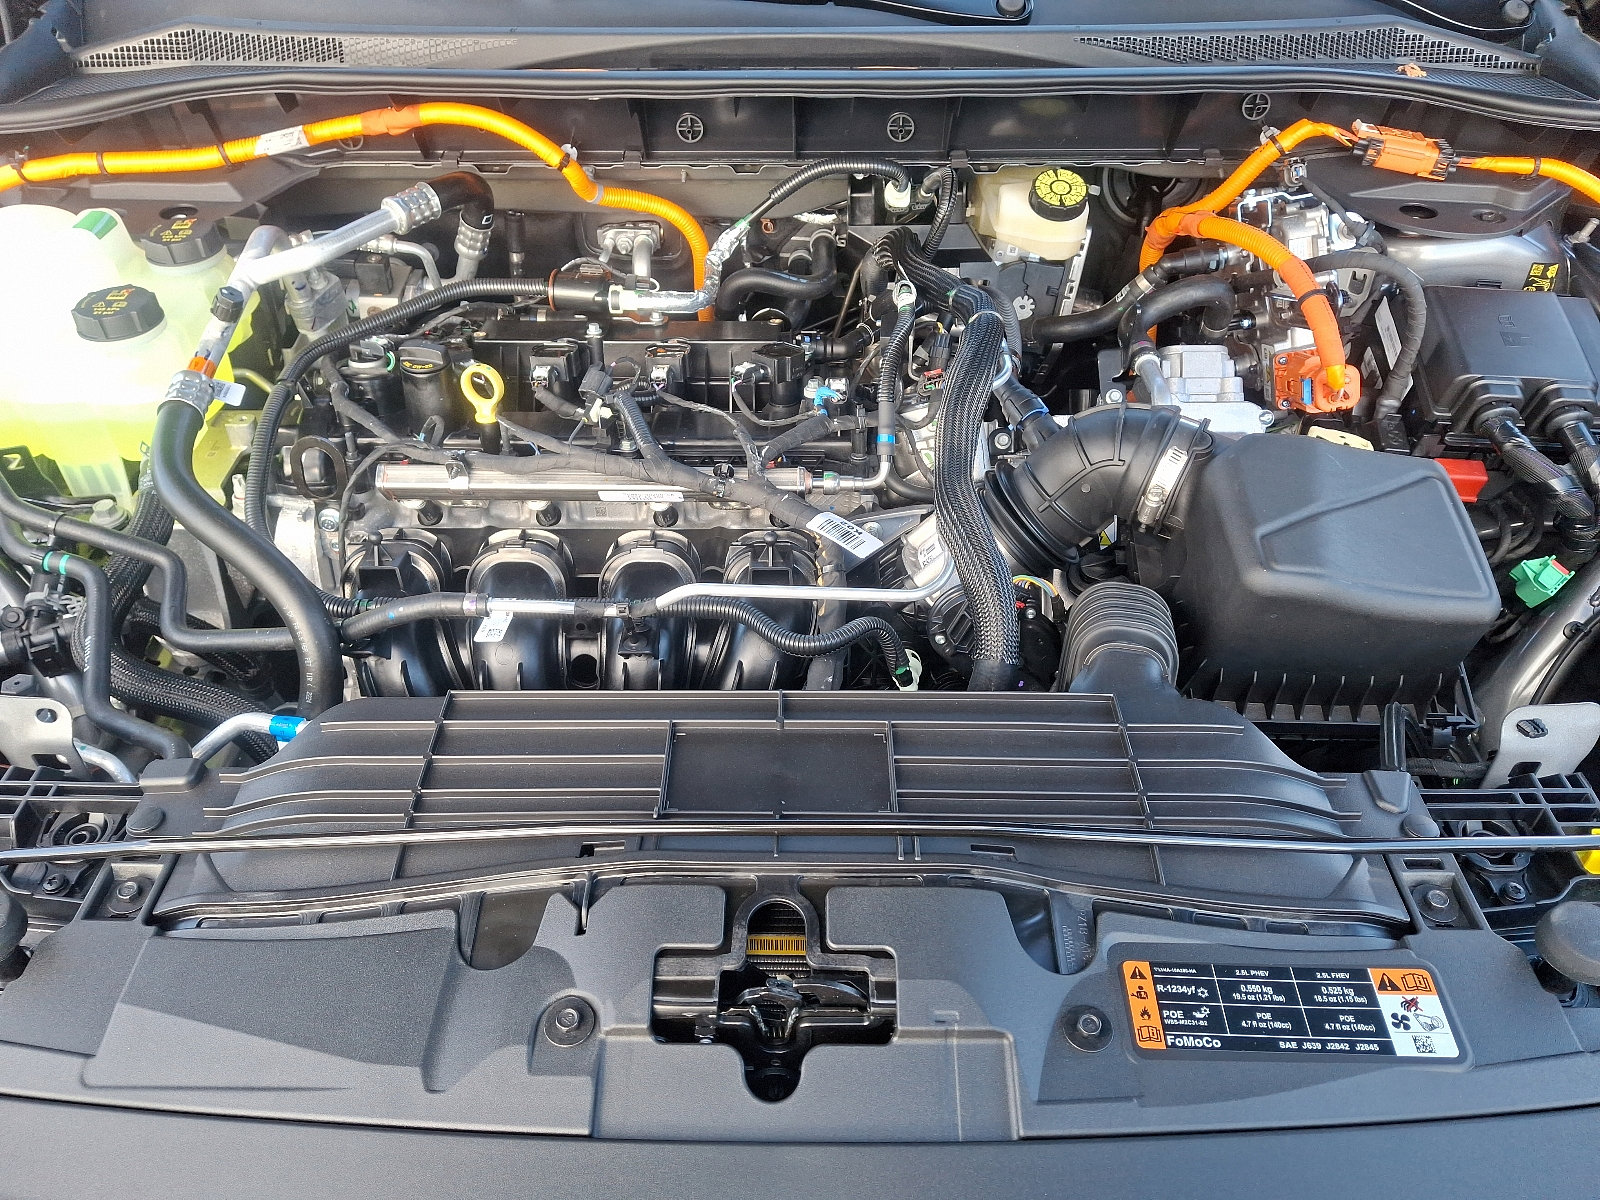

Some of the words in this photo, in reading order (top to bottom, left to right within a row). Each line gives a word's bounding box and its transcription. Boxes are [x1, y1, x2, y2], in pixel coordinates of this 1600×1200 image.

[1156, 984, 1196, 995] R-1234yf
[1262, 985, 1273, 995] kg
[1343, 986, 1354, 996] kg
[1162, 1010, 1185, 1019] POE
[1256, 1012, 1273, 1020] POE
[1339, 1014, 1356, 1022] POE
[1166, 1035, 1222, 1048] FoMoCo
[1279, 1041, 1299, 1049] SAE
